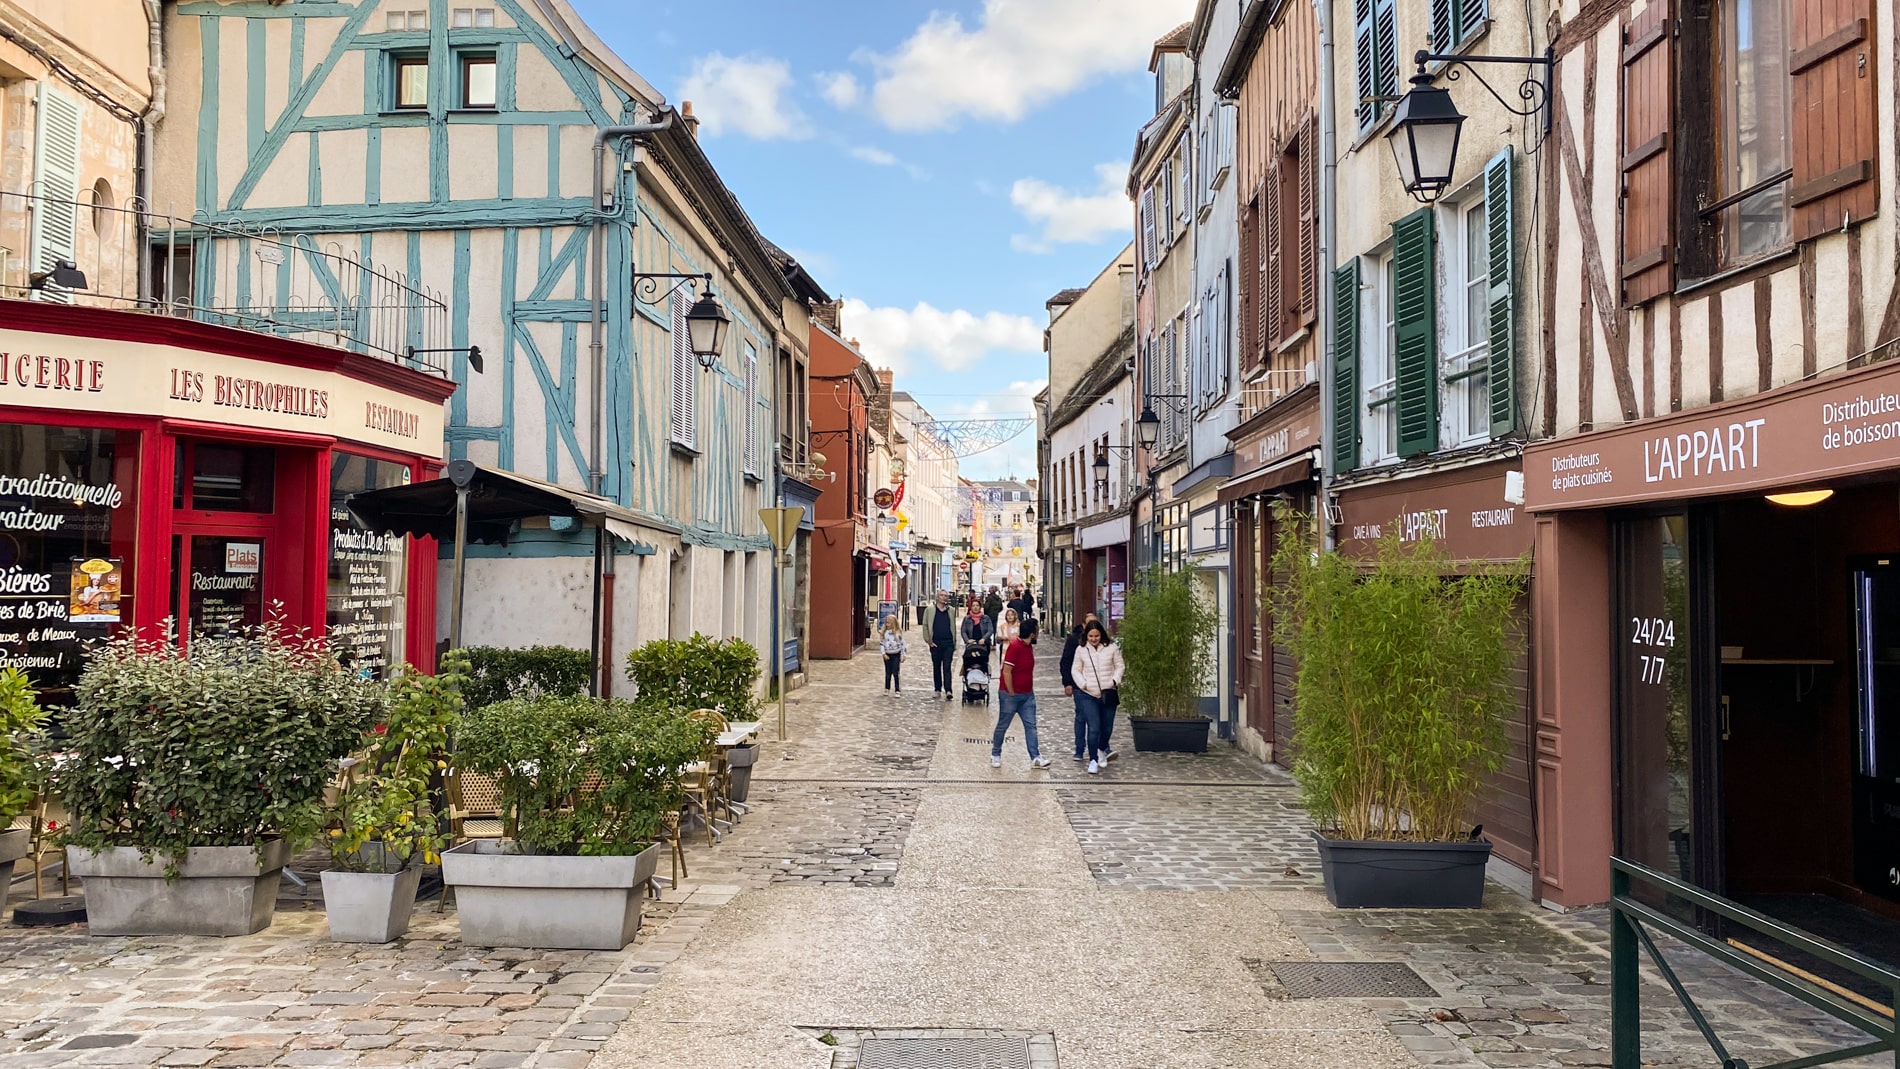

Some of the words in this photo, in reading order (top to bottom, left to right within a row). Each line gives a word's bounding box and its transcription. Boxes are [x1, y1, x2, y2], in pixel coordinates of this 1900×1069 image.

[169, 368, 205, 403] LES
[213, 375, 329, 419] BISTROPHILES
[364, 401, 420, 440] RESTAURANT
[1822, 427, 1841, 450] de
[1643, 418, 1766, 483] L'APPART
[1552, 452, 1600, 473] Distributeurs
[1552, 475, 1562, 490] de
[1562, 473, 1581, 492] plats
[1581, 466, 1613, 485] cuisinés
[0, 473, 122, 509] traditionnelle
[1471, 507, 1515, 528] RESTAURANT
[334, 528, 360, 549] Produits
[1353, 525, 1366, 540] CAVE
[1369, 524, 1381, 539] VINS
[227, 548, 257, 562] Plats
[192, 571, 256, 591] Restaurant
[18, 601, 34, 620] de
[36, 600, 68, 621] Brie,
[26, 628, 39, 642] de
[41, 627, 80, 642] Meaux,
[1632, 617, 1675, 647] 24/24
[1641, 656, 1664, 684] 7/7
